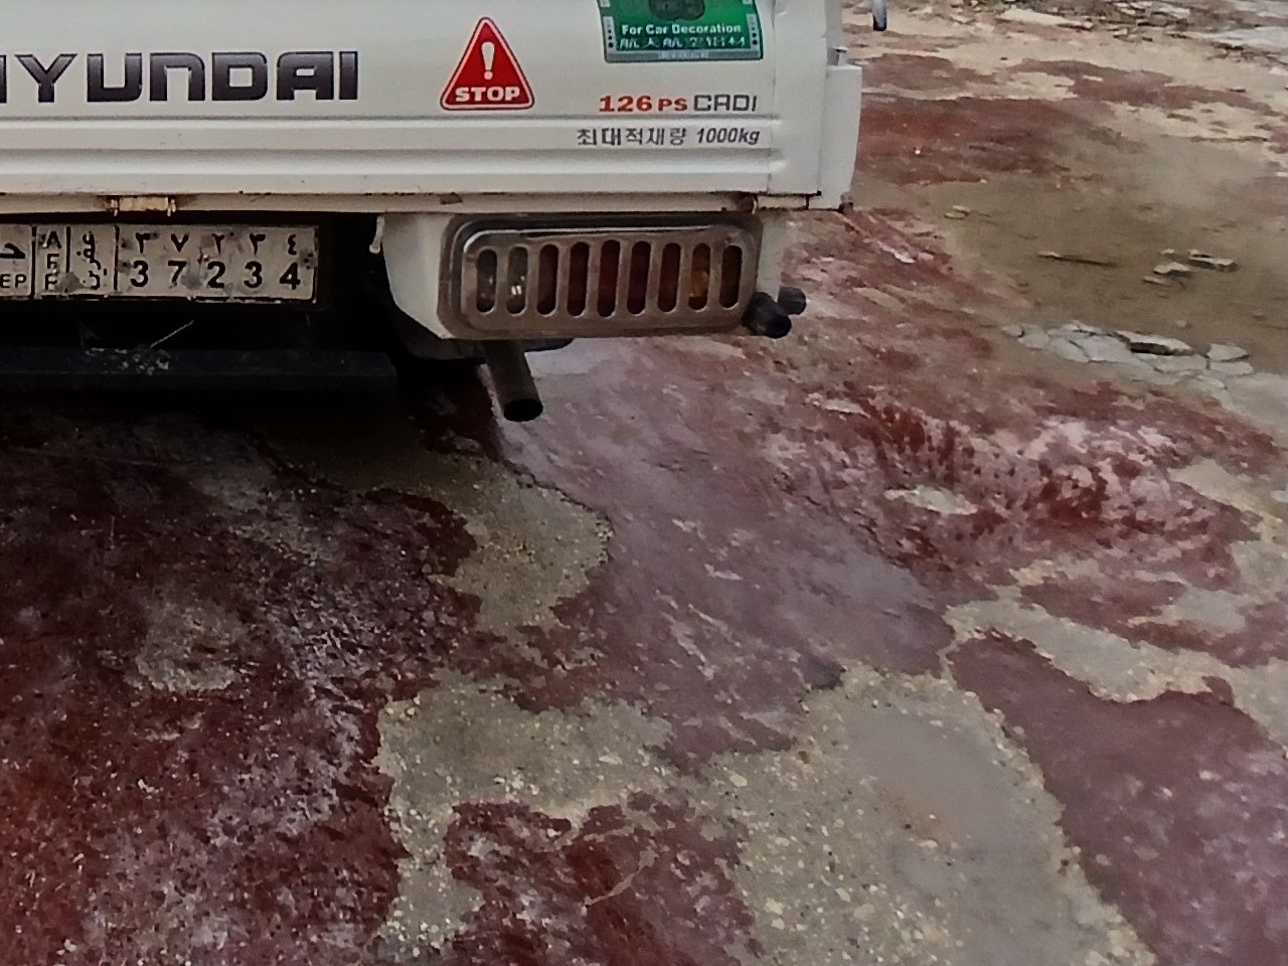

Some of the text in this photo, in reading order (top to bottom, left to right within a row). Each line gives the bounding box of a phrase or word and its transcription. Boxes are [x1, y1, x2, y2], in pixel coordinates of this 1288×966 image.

[621, 23, 742, 36] For Car Decoration
[455, 86, 520, 102] STOP
[599, 94, 653, 112] 126
[577, 127, 760, 146] 최대적재량 1000kg
[130, 260, 301, 290] 37234
